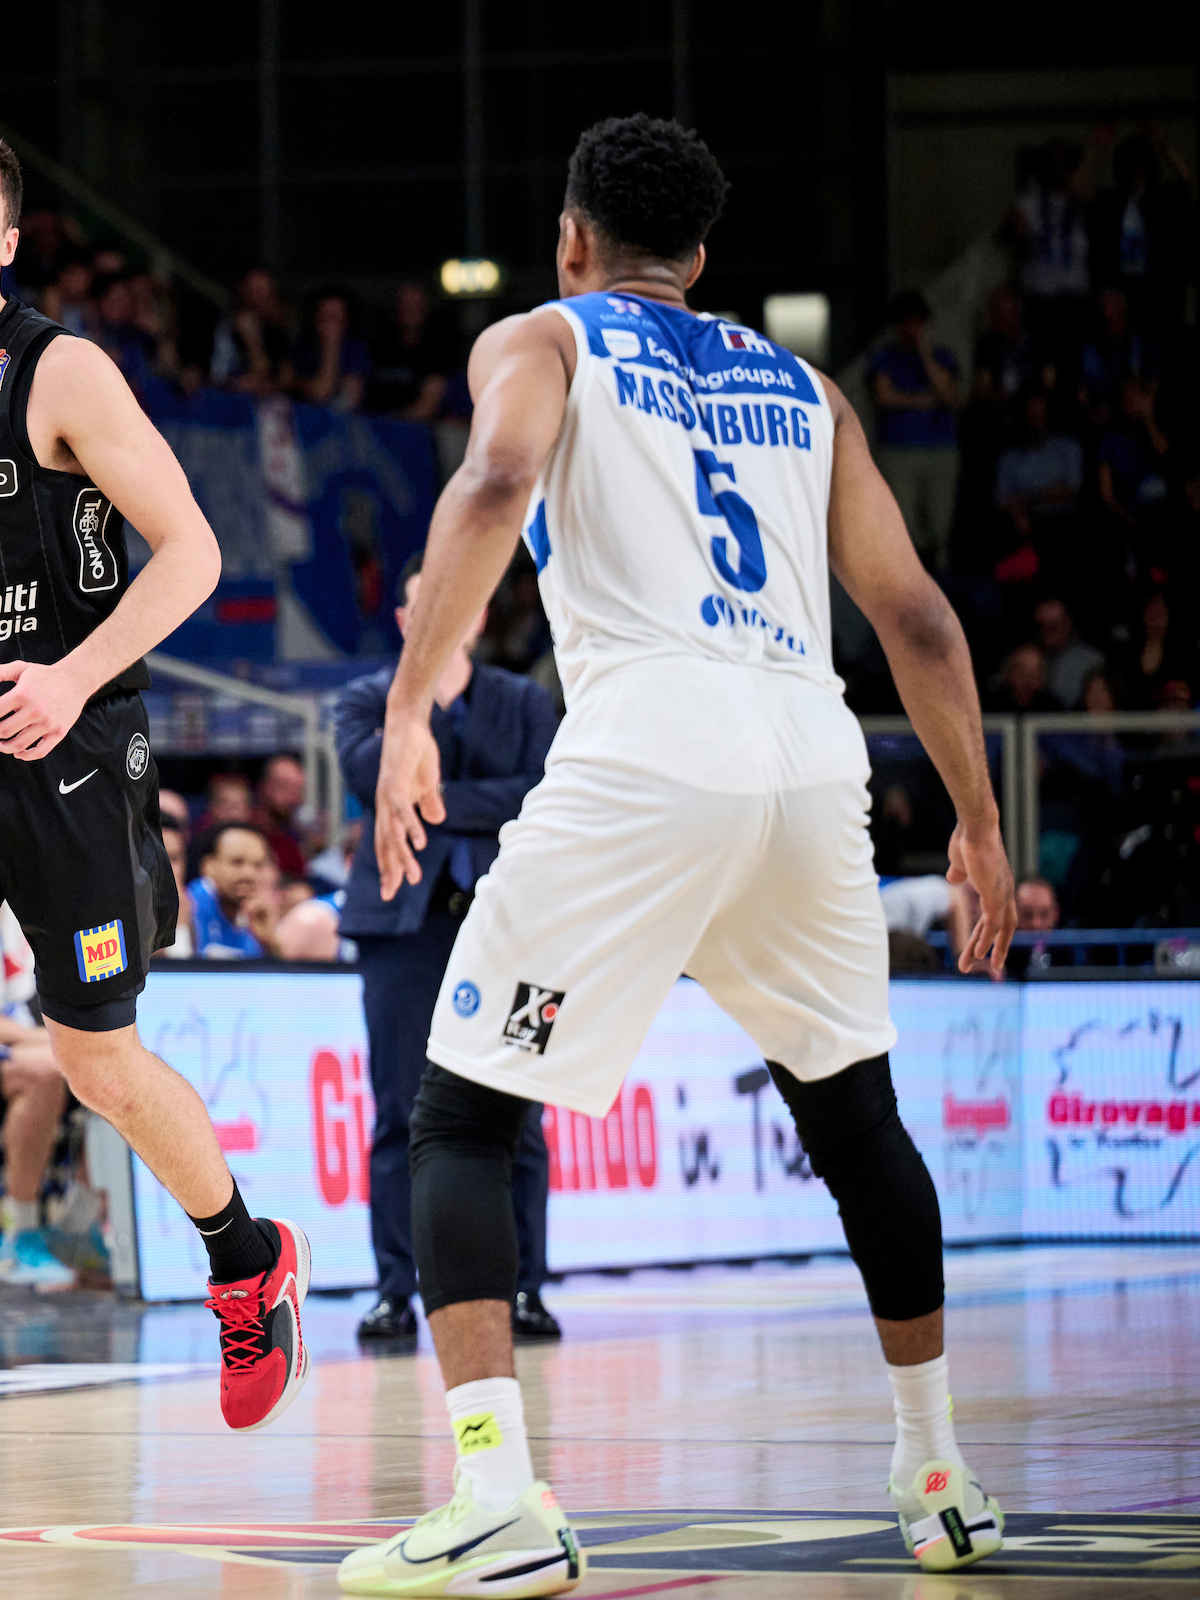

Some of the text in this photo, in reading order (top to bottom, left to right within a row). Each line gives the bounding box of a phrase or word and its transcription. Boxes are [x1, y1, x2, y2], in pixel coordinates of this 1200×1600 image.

[613, 366, 811, 451] MASSNBURG
[80, 499, 104, 579] TRENTINO
[692, 448, 767, 593] 5
[86, 938, 118, 963] MD
